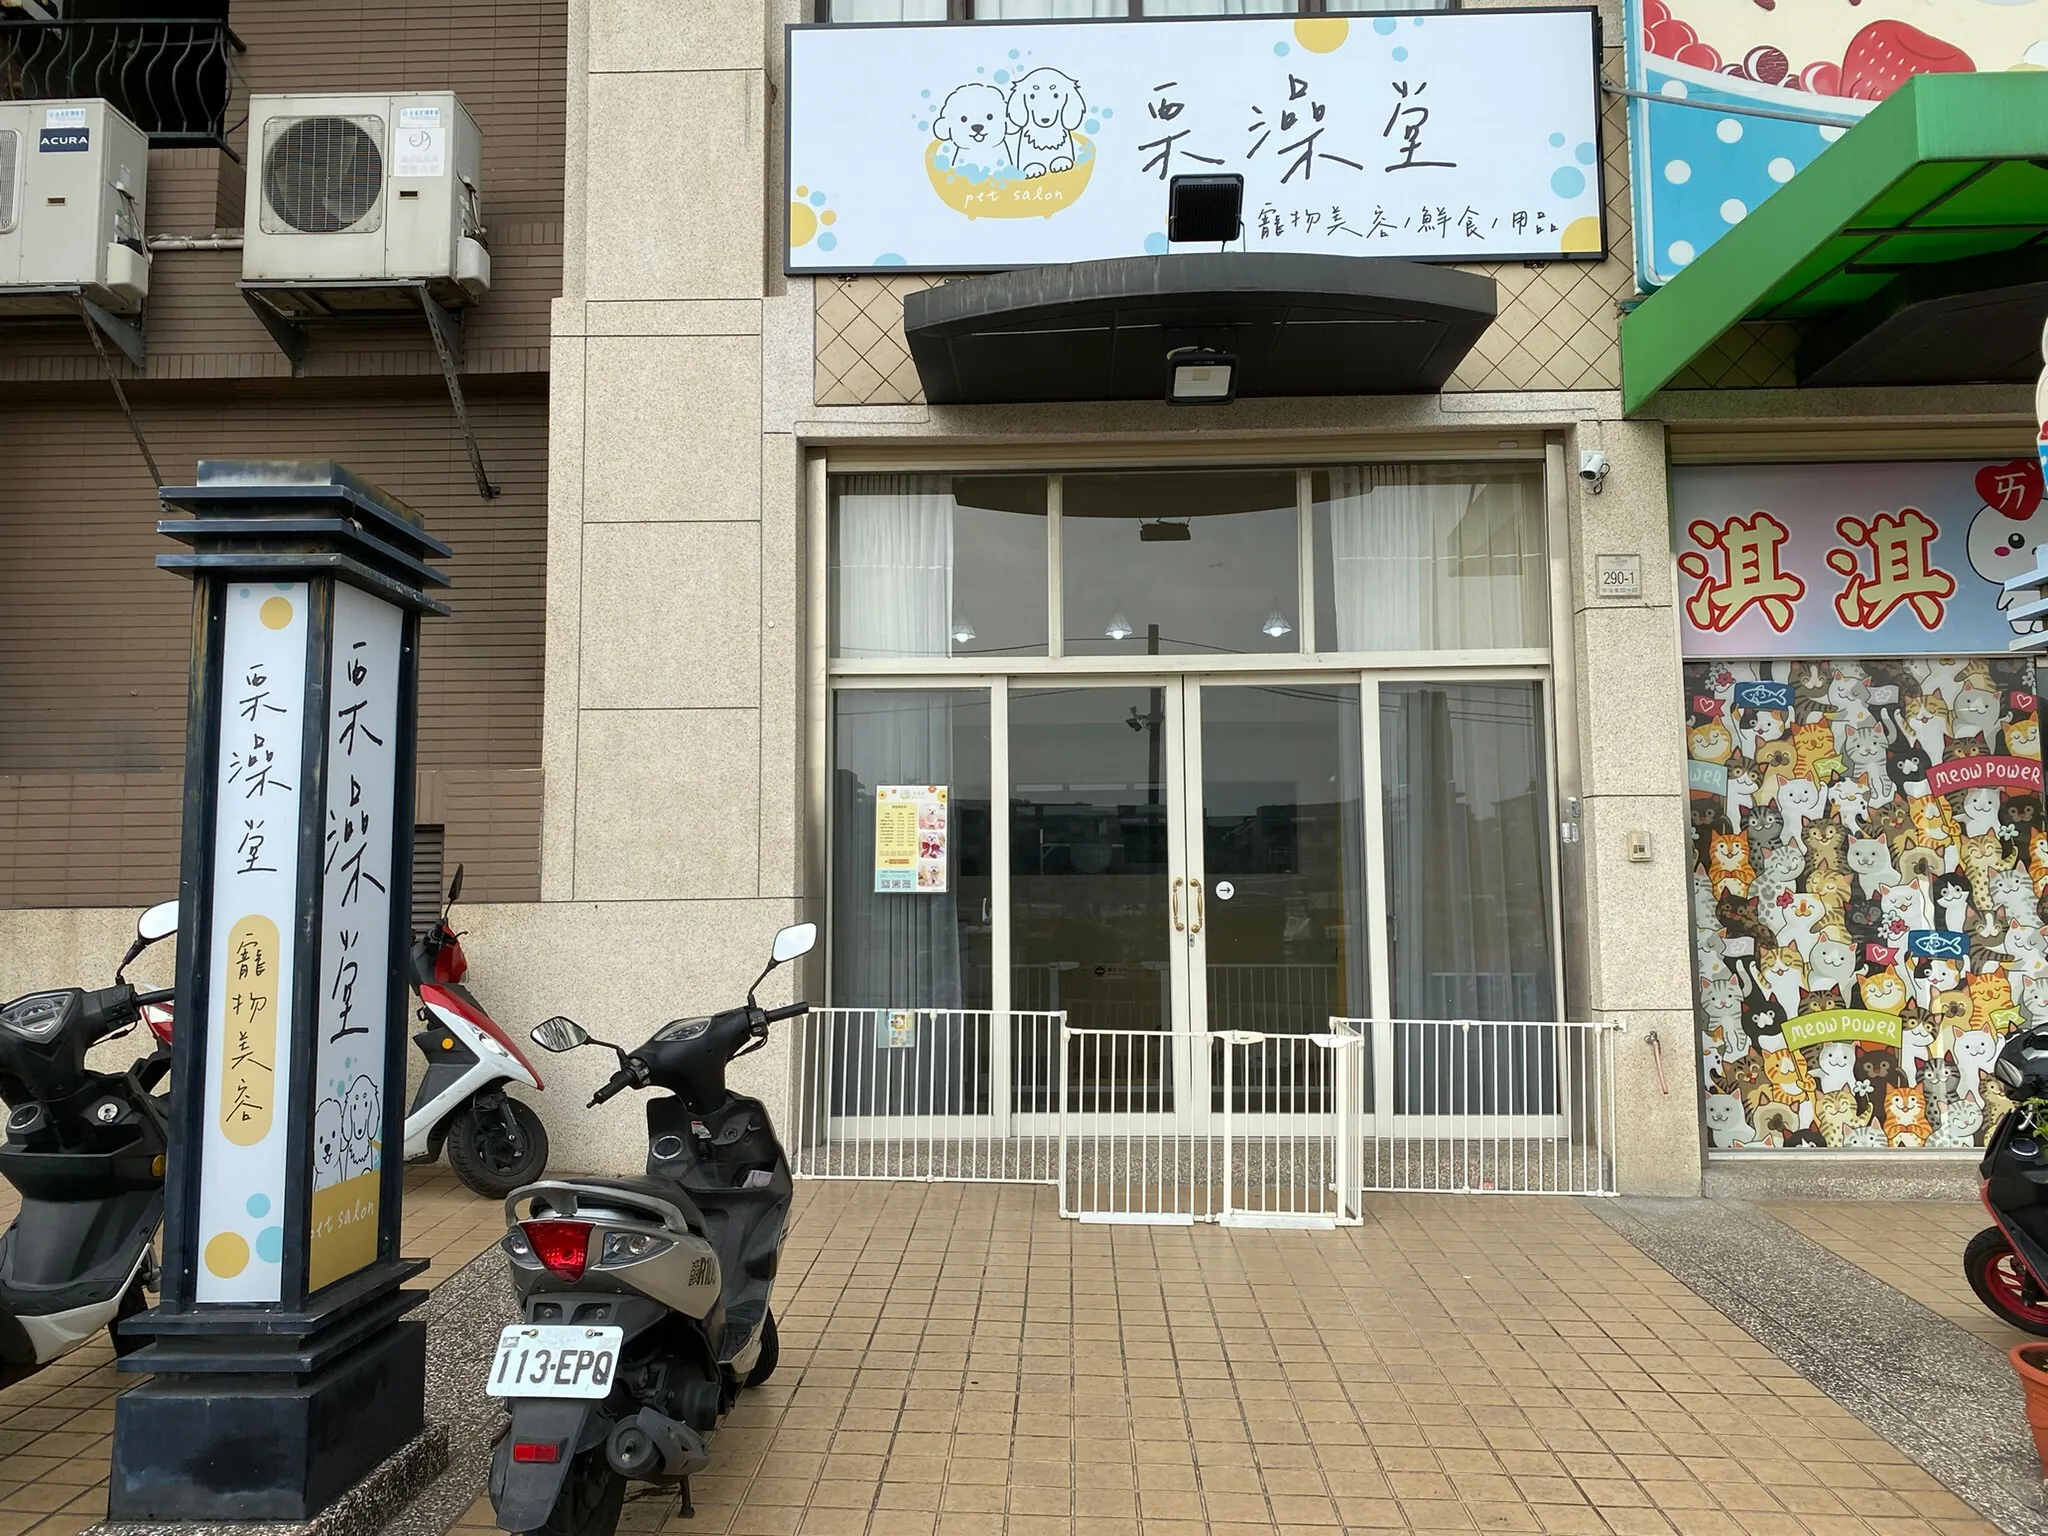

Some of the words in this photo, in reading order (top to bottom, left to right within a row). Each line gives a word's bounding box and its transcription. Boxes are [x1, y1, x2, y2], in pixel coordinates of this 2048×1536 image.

[41, 136, 88, 145] ACURA
[964, 190, 999, 208] pet
[1013, 186, 1063, 201] salon
[1603, 571, 1634, 585] 290-1
[1678, 507, 1957, 635] 淇淇
[226, 933, 272, 1122] 寵物美容
[337, 1198, 374, 1229] salon
[497, 1349, 613, 1386] 113-EPQ
